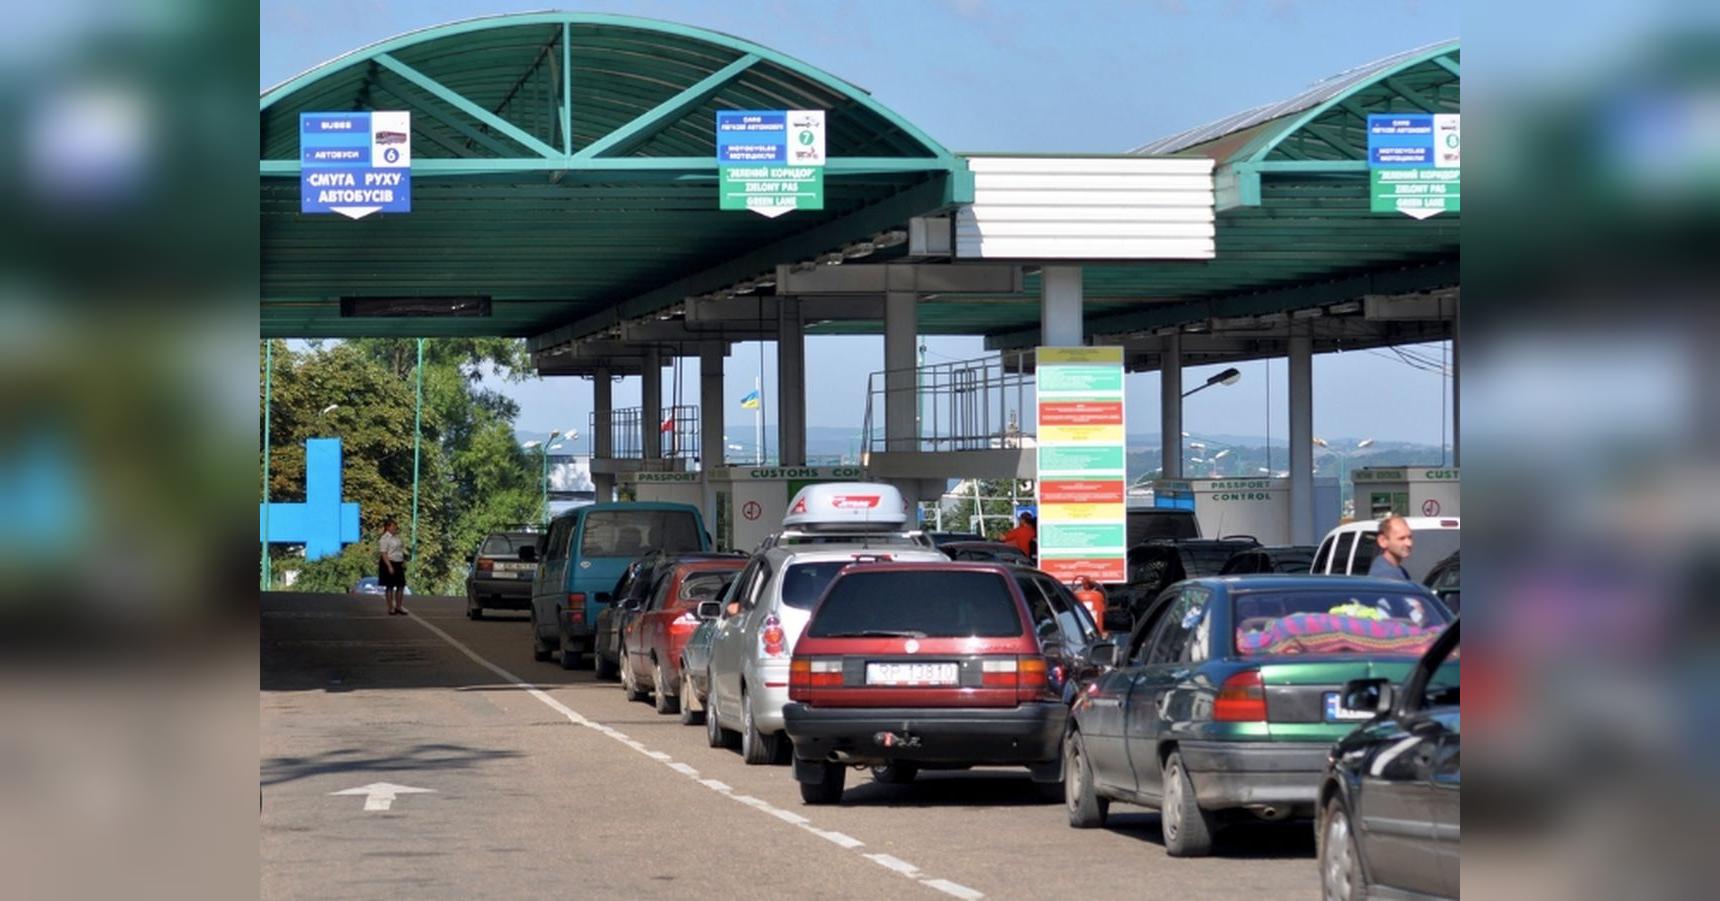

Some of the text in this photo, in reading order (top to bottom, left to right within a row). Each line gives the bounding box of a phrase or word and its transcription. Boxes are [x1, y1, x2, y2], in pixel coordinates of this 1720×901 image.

[321, 121, 352, 129] BUSES
[314, 151, 360, 159] АВТОБУСИ
[387, 148, 396, 161] 6
[309, 172, 401, 186] СМУГА РУХУ
[318, 190, 394, 202] АВТОБУСІВ
[746, 196, 797, 206] GREEN LANE
[638, 473, 696, 481] PASSPORT
[751, 468, 818, 478] CUSTOMS
[1211, 481, 1271, 489] PASSPORT
[1211, 492, 1272, 501] CONTROL
